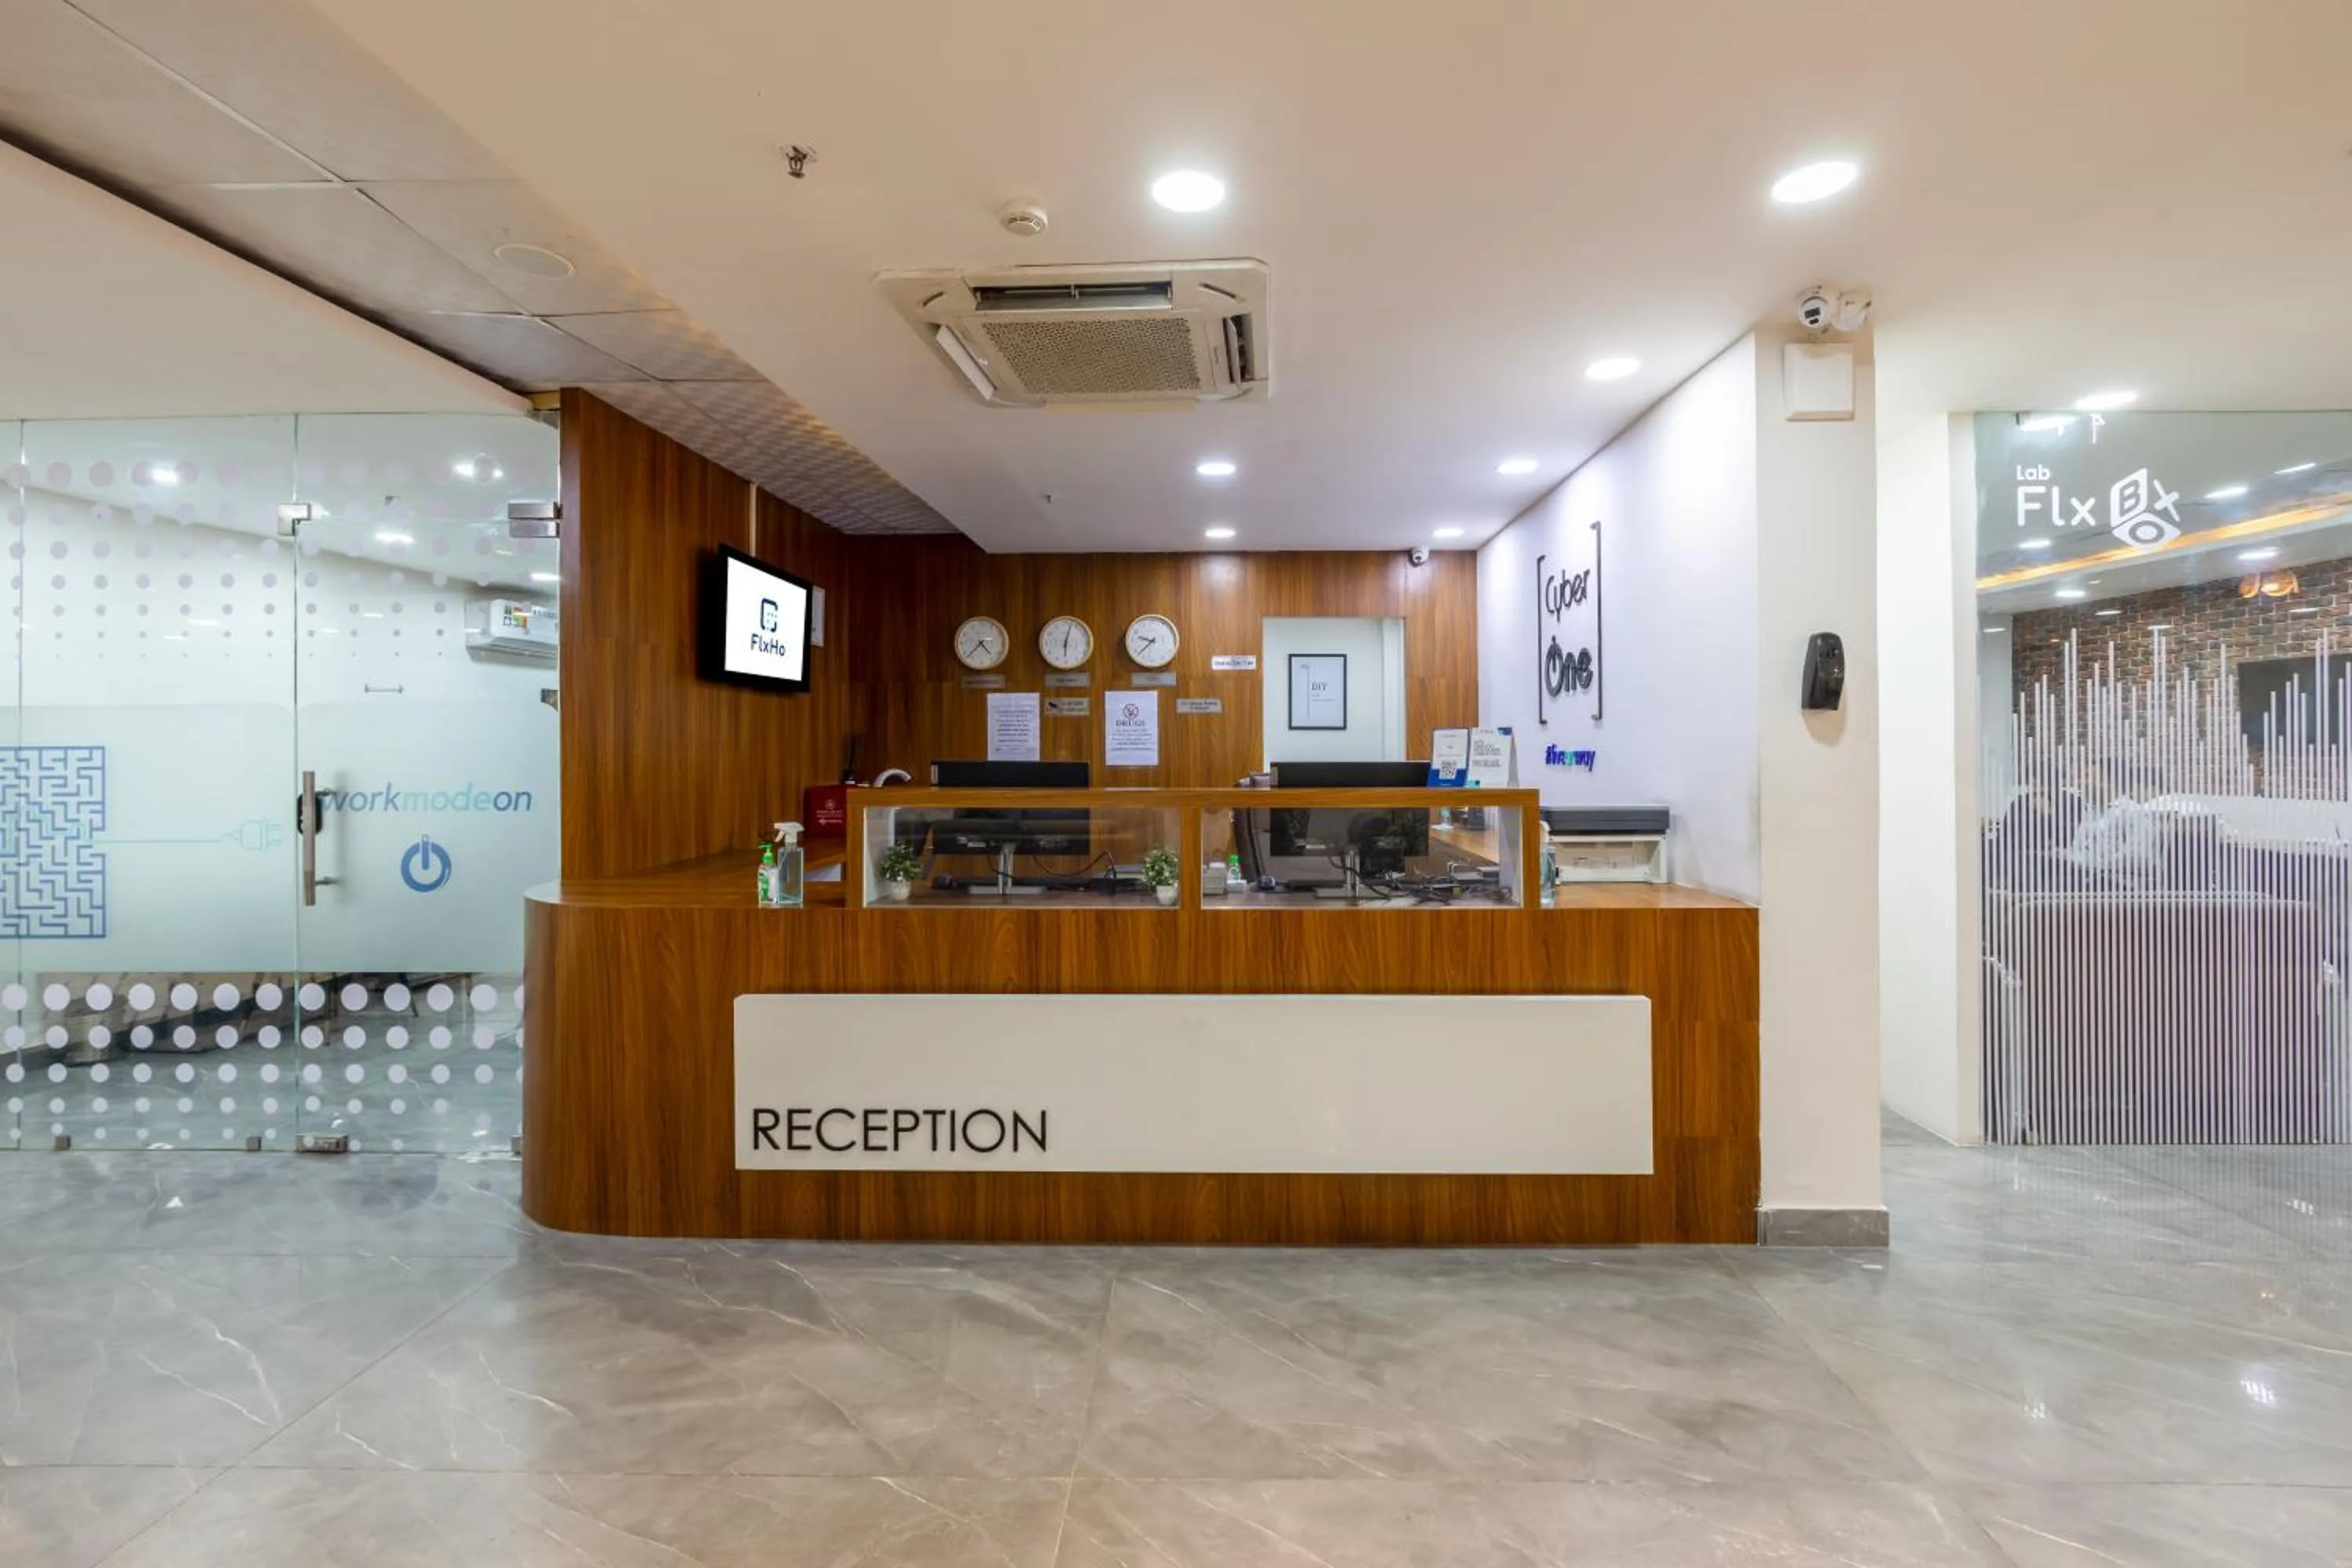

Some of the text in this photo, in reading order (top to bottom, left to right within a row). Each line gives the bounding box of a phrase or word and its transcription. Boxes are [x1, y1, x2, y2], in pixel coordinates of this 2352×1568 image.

[2016, 465, 2051, 481] Lab
[2017, 486, 2096, 526] Flx
[1545, 569, 1590, 622] Cyber
[751, 633, 786, 656] FlxHo
[1545, 636, 1593, 697] One
[753, 1108, 1046, 1152] RECEPTION
